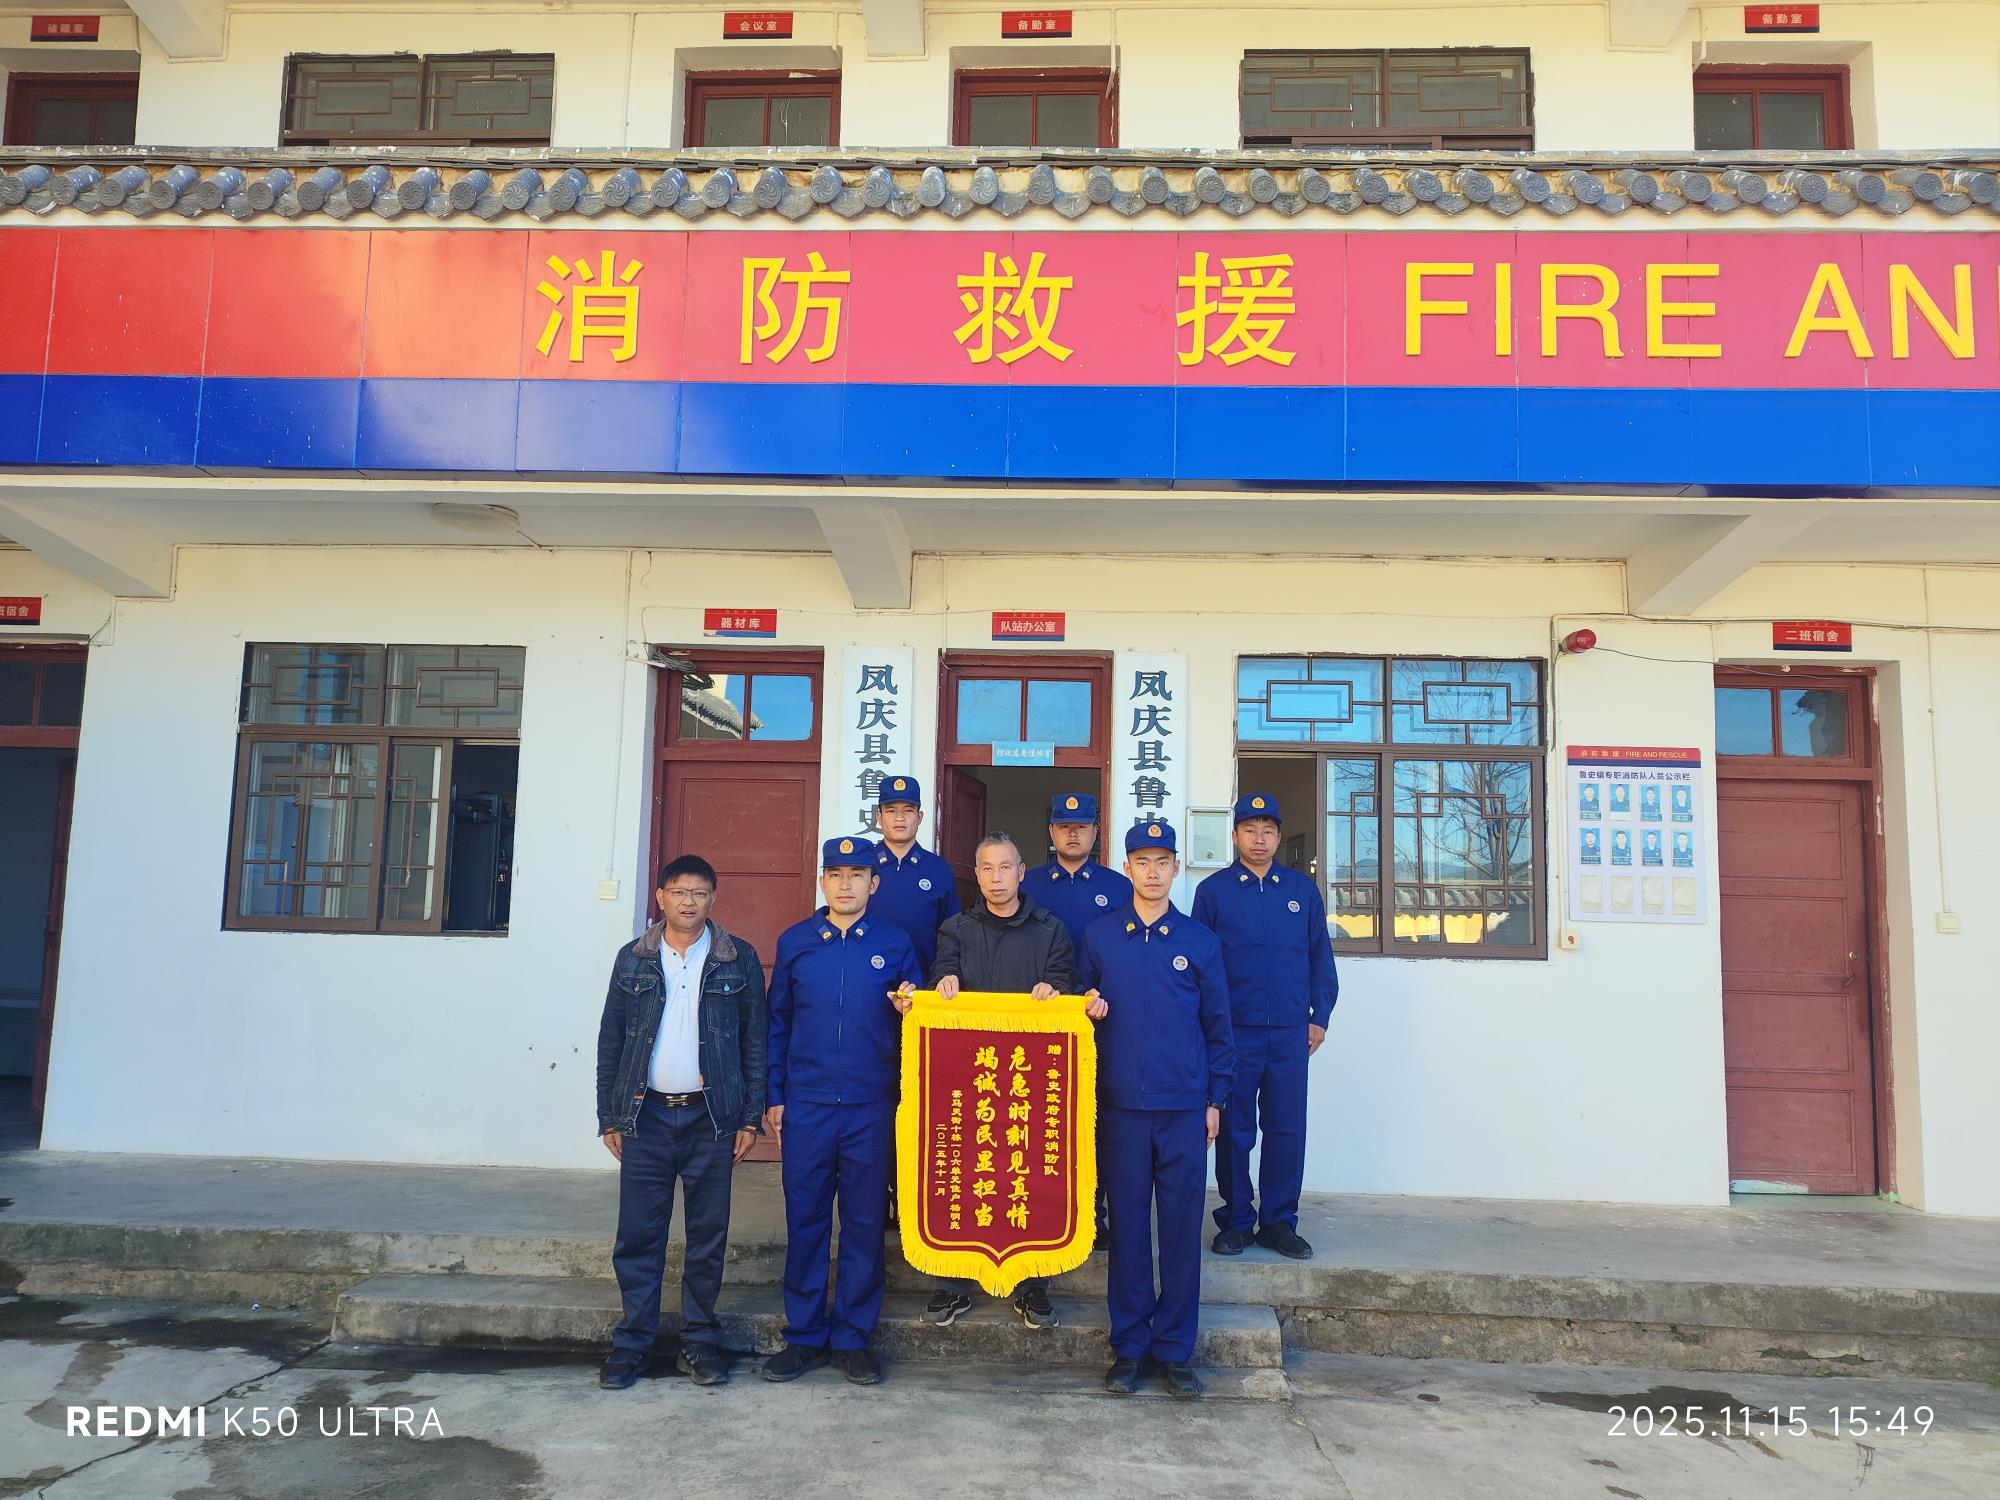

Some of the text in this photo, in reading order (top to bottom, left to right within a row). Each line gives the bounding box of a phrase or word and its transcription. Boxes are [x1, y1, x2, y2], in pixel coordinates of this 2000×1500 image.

[1018, 19, 1056, 30] 备勤室
[1762, 14, 1802, 24] 备勤室
[740, 21, 777, 31] 会议室
[535, 250, 1297, 367] 消防救援
[1405, 262, 2000, 359] FIRE AN
[721, 617, 760, 629] 器材库
[1001, 621, 1056, 632] 队站办公室
[1786, 630, 1838, 642] 二班宿舍
[1658, 751, 1688, 759] RESCUE
[1006, 1045, 1032, 1230] 危急时刻见真情
